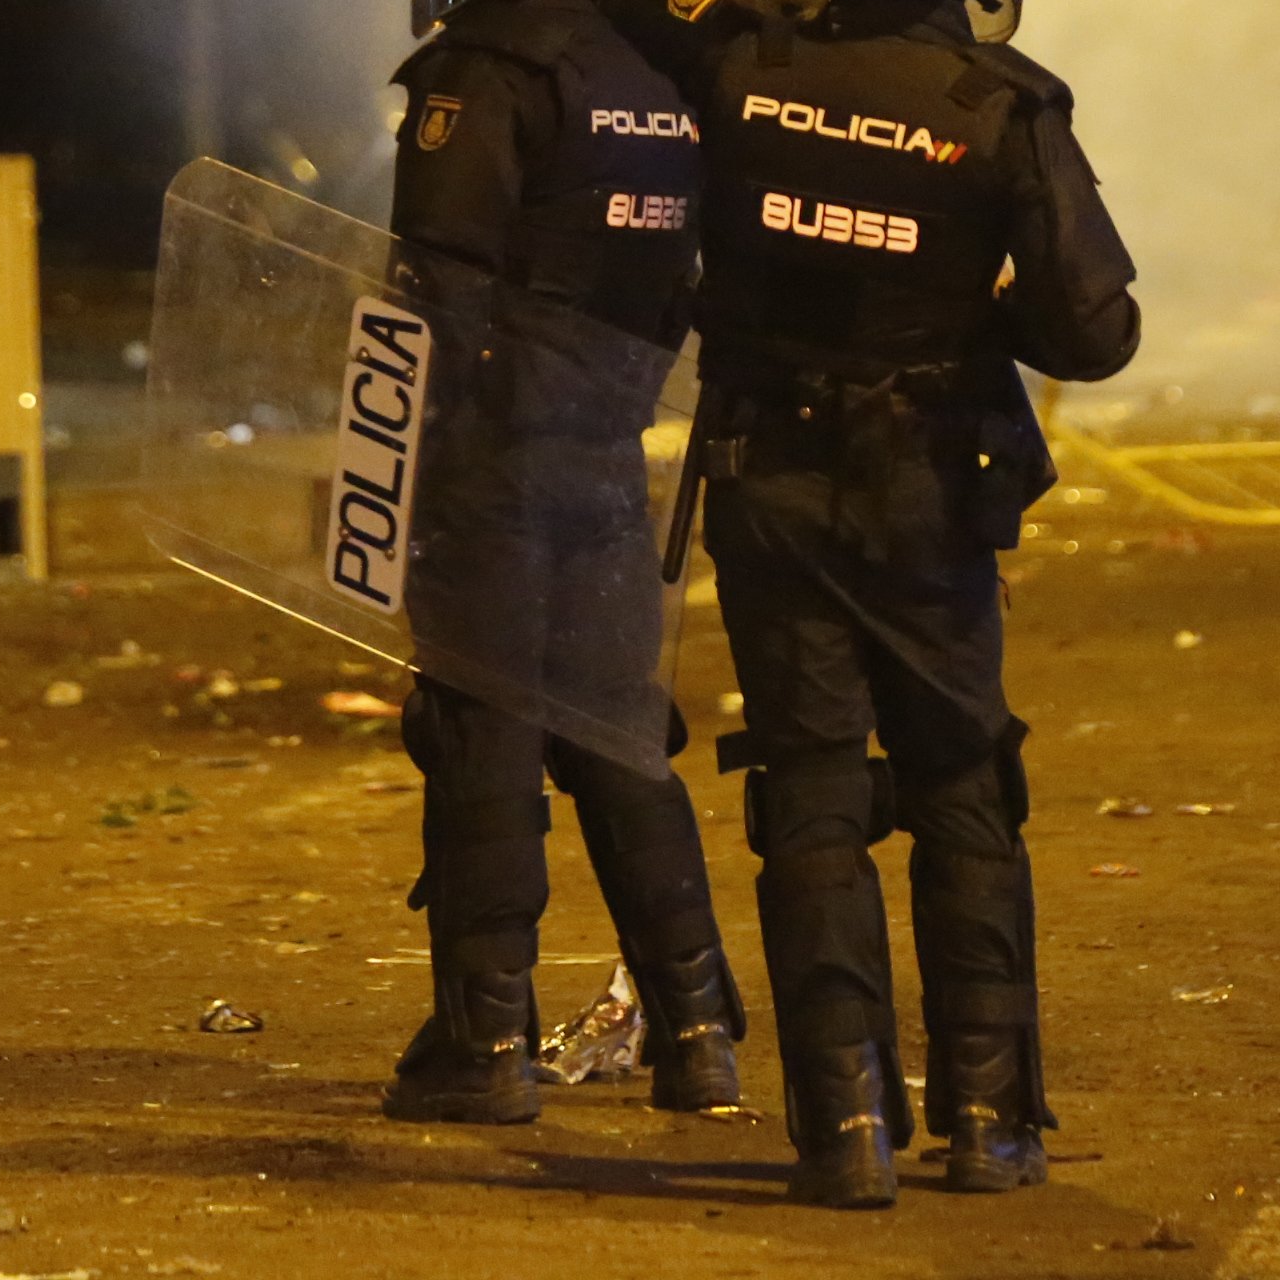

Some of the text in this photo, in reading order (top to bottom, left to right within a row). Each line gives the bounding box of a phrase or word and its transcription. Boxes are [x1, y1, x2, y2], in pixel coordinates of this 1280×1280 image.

[591, 109, 697, 139] POLICIA
[743, 94, 936, 157] POLICIA
[761, 191, 920, 254] 8U353
[333, 312, 422, 606] POLICIA
